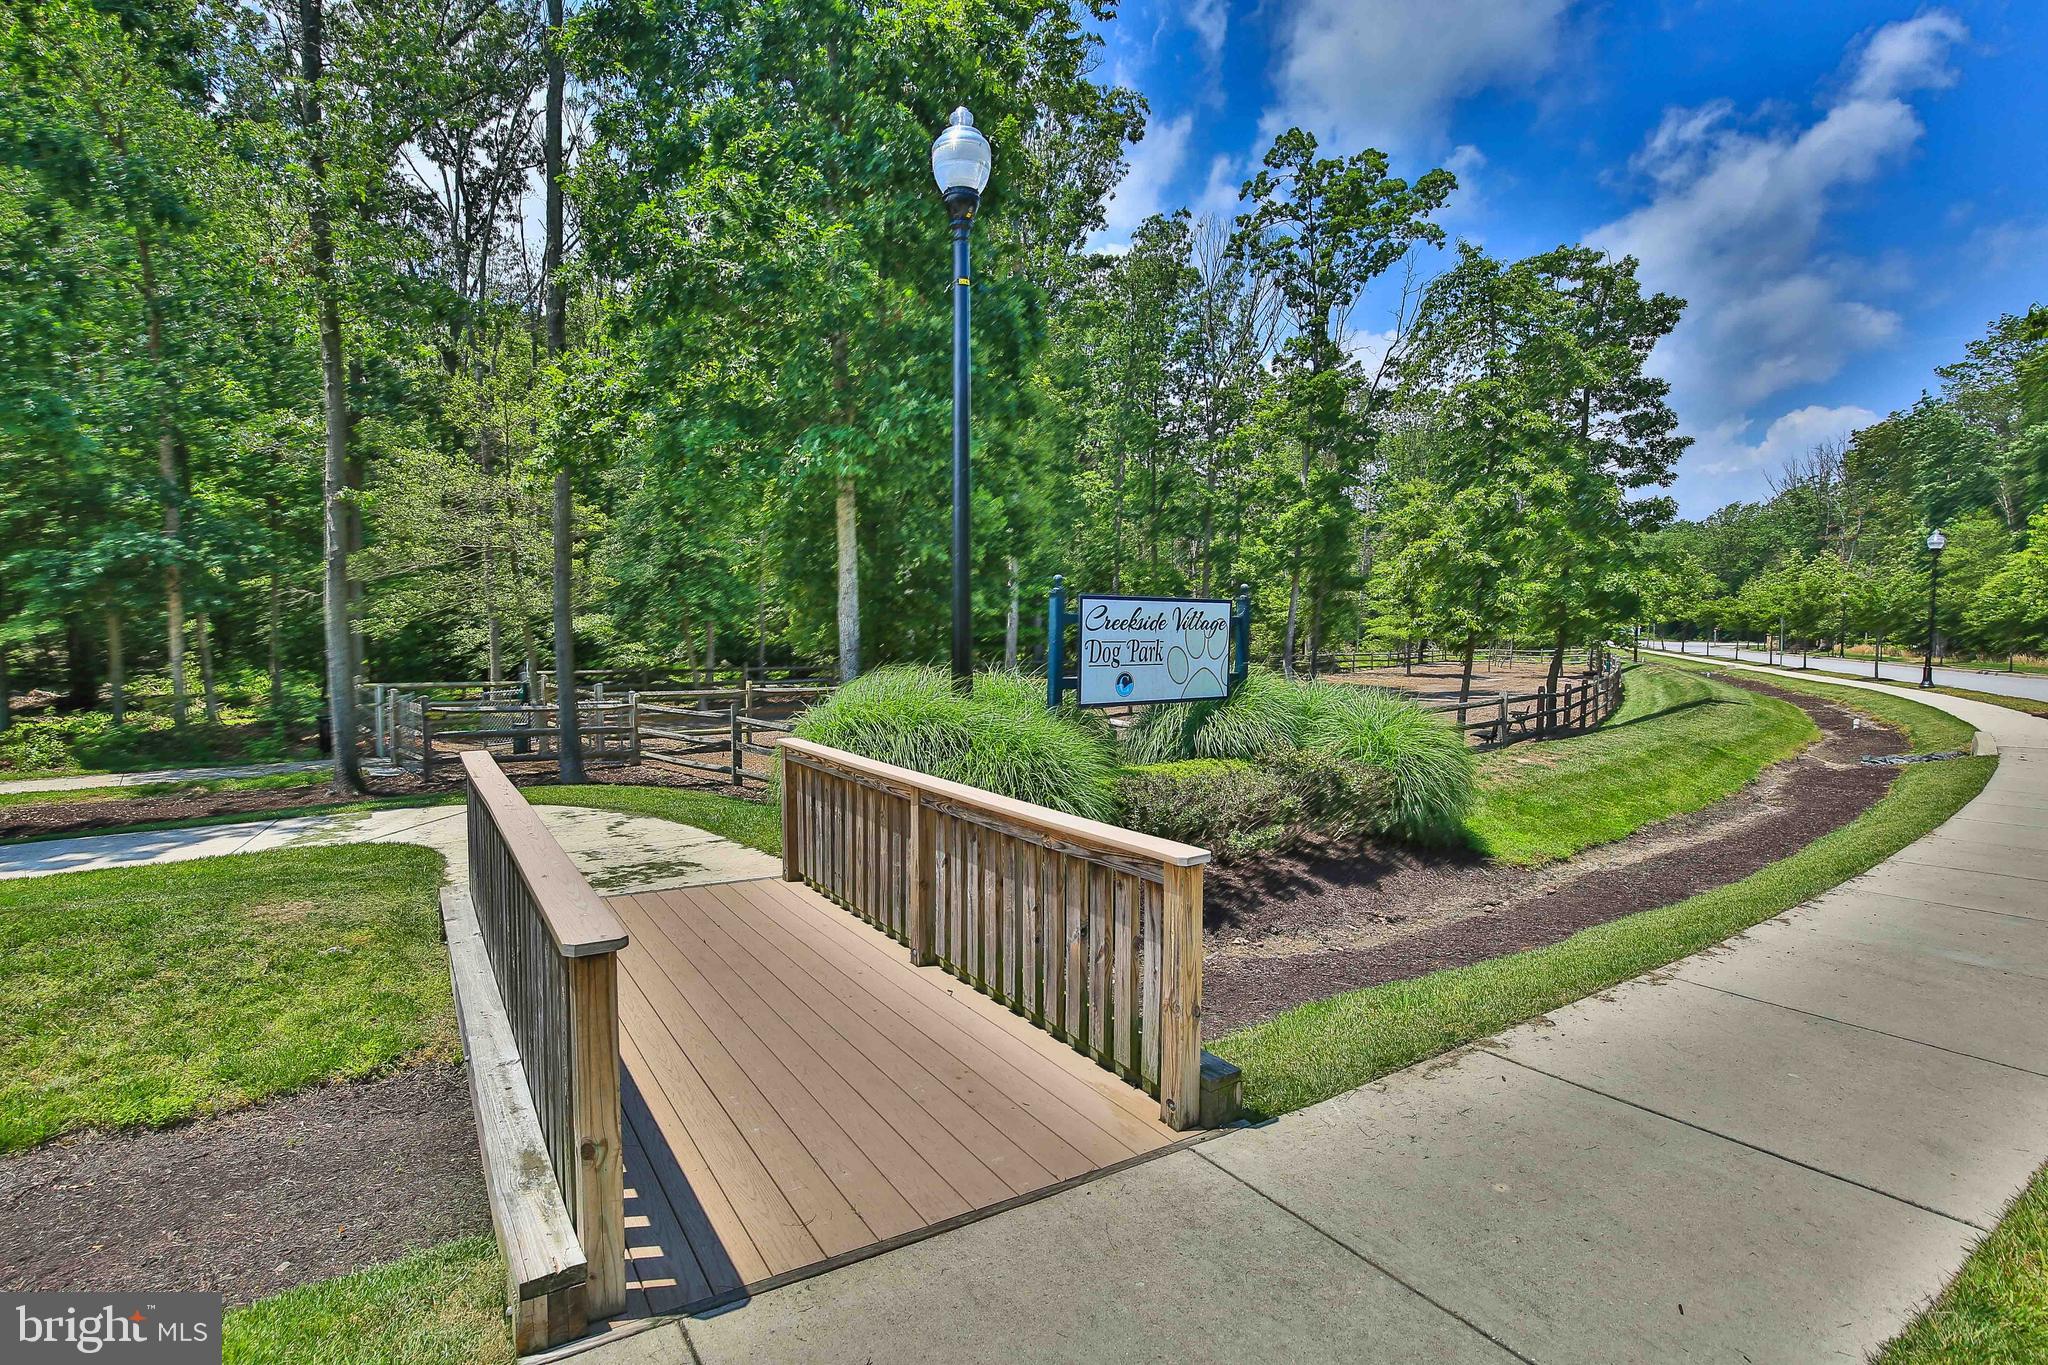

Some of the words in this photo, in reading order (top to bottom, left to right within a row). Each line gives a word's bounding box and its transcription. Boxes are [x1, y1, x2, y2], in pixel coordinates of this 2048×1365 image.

[1085, 604, 1168, 633] Creekside
[1172, 606, 1227, 639] Village
[1084, 639, 1121, 668] Dog
[1126, 639, 1164, 663] Park
